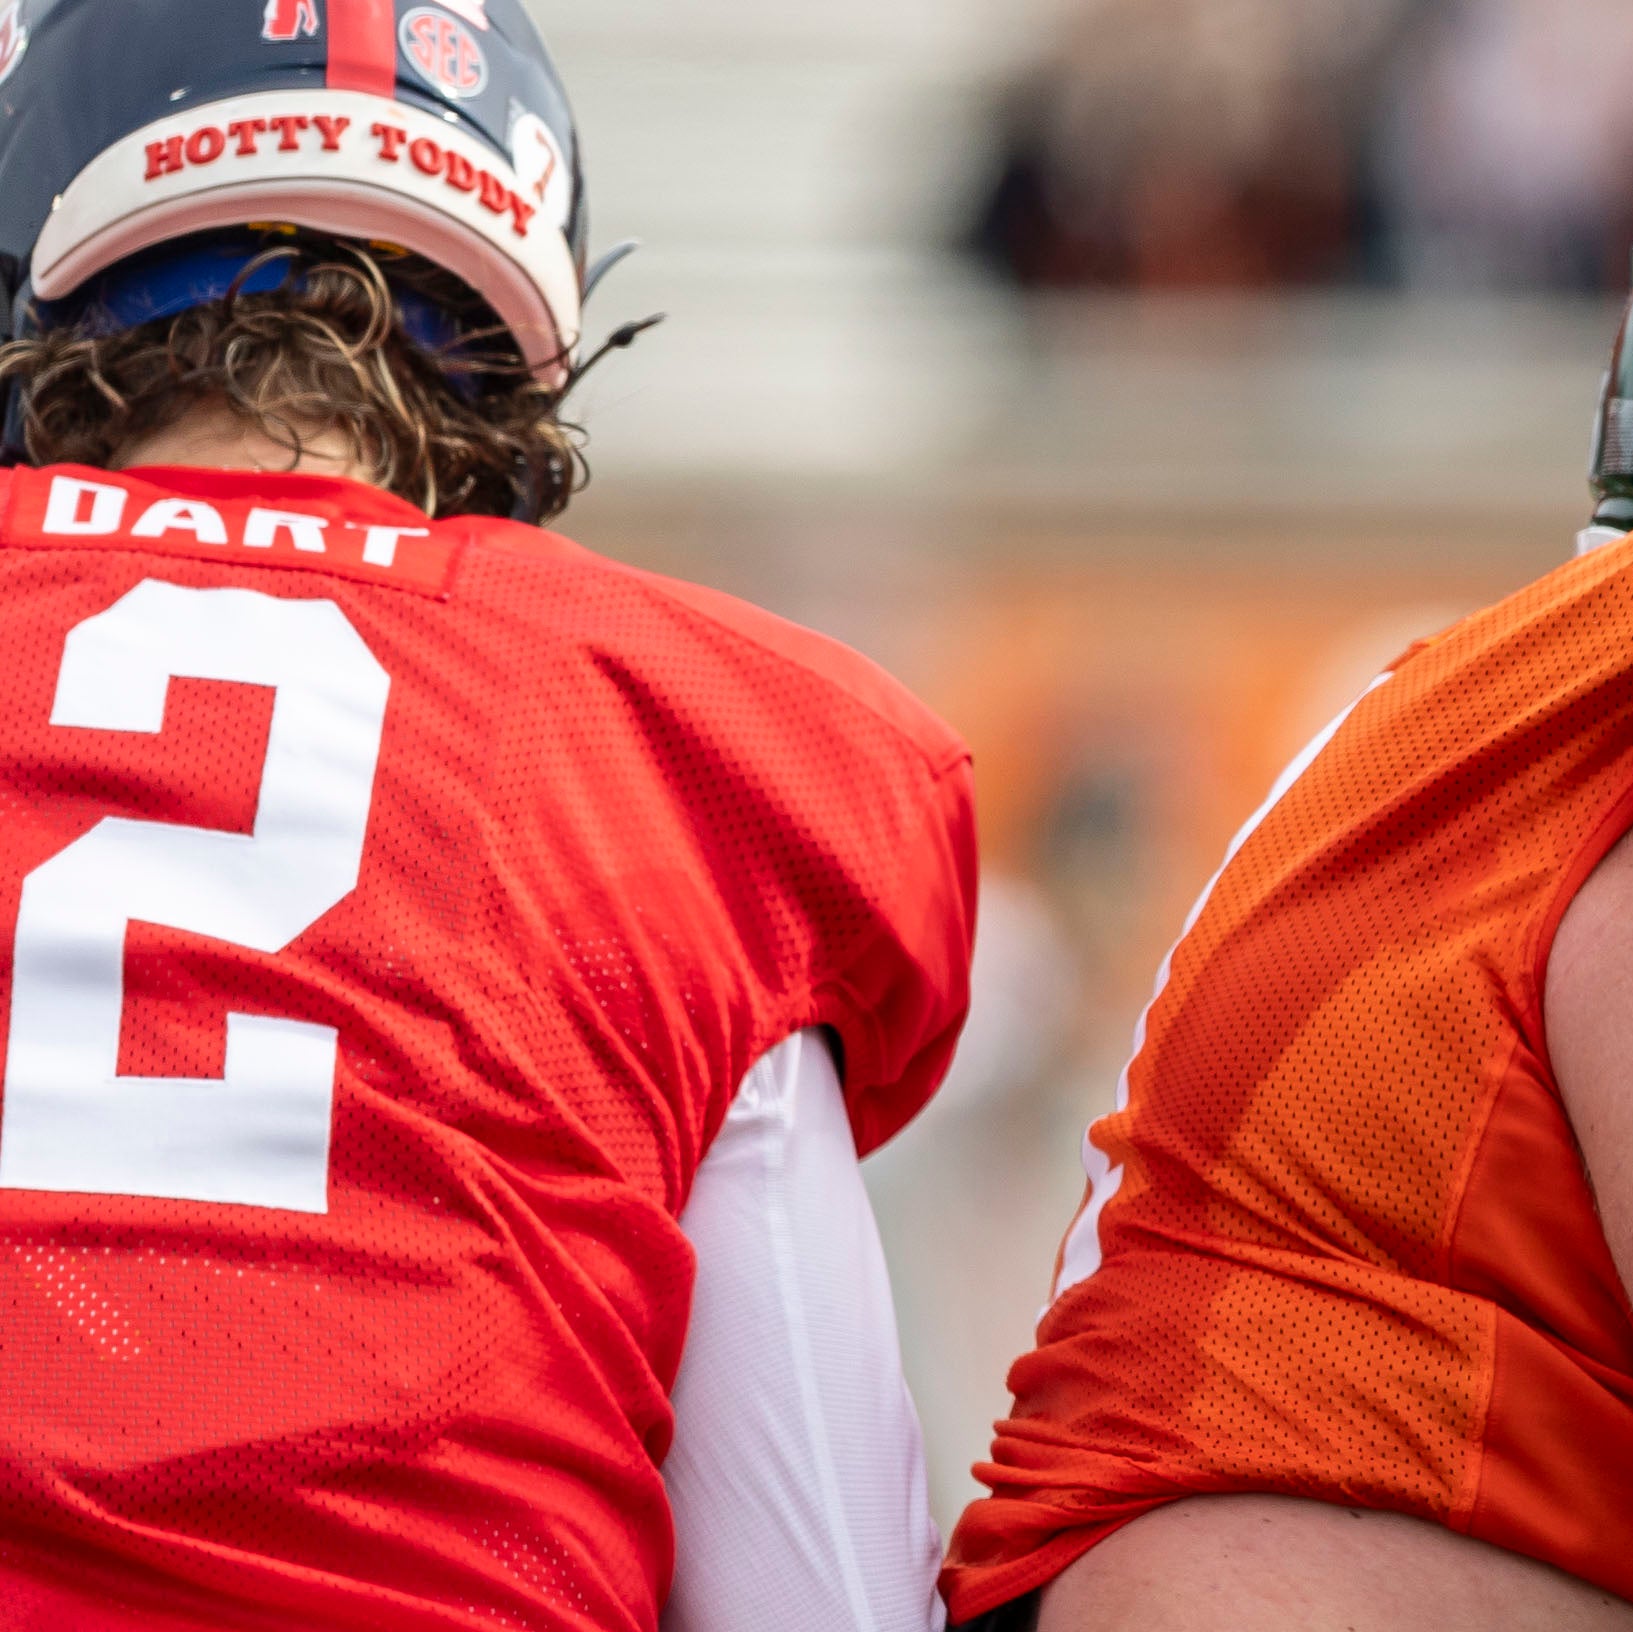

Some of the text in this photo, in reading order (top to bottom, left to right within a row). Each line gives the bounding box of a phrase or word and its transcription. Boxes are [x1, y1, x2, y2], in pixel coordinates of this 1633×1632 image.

[408, 15, 481, 88] SEC
[144, 115, 349, 182] HOTTY
[371, 121, 535, 237] TODDY
[43, 475, 429, 566] DART
[0, 578, 391, 1214] 2
